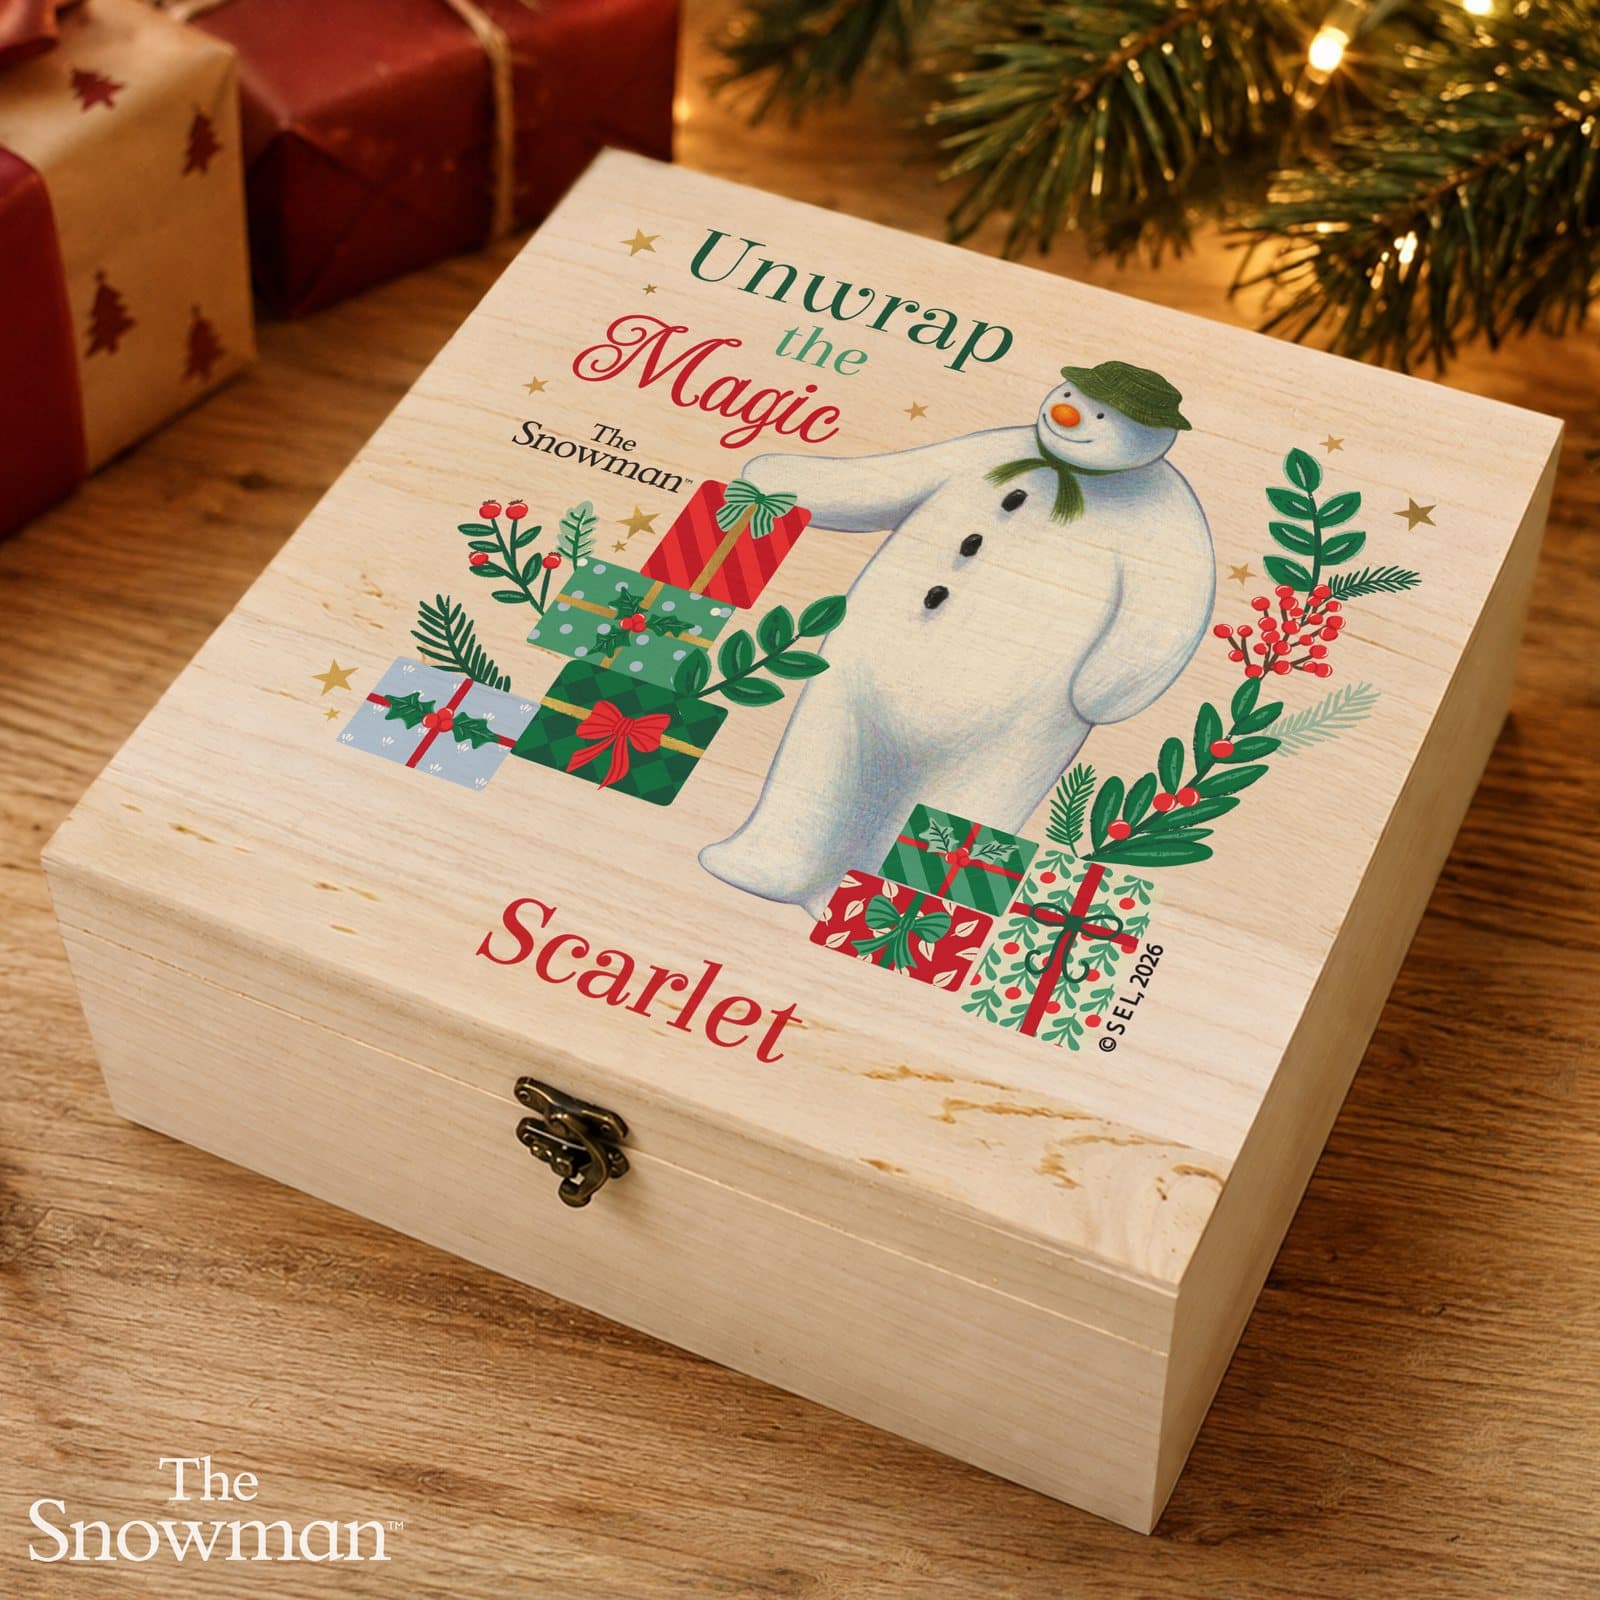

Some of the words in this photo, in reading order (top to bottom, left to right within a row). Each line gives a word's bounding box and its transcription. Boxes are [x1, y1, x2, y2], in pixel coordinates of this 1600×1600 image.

[689, 228, 1014, 373] Unwrap
[572, 314, 840, 449] Magic
[775, 325, 869, 376] the
[590, 423, 637, 452] The
[475, 897, 803, 1063] Scarlet
[1129, 943, 1164, 989] 2026
